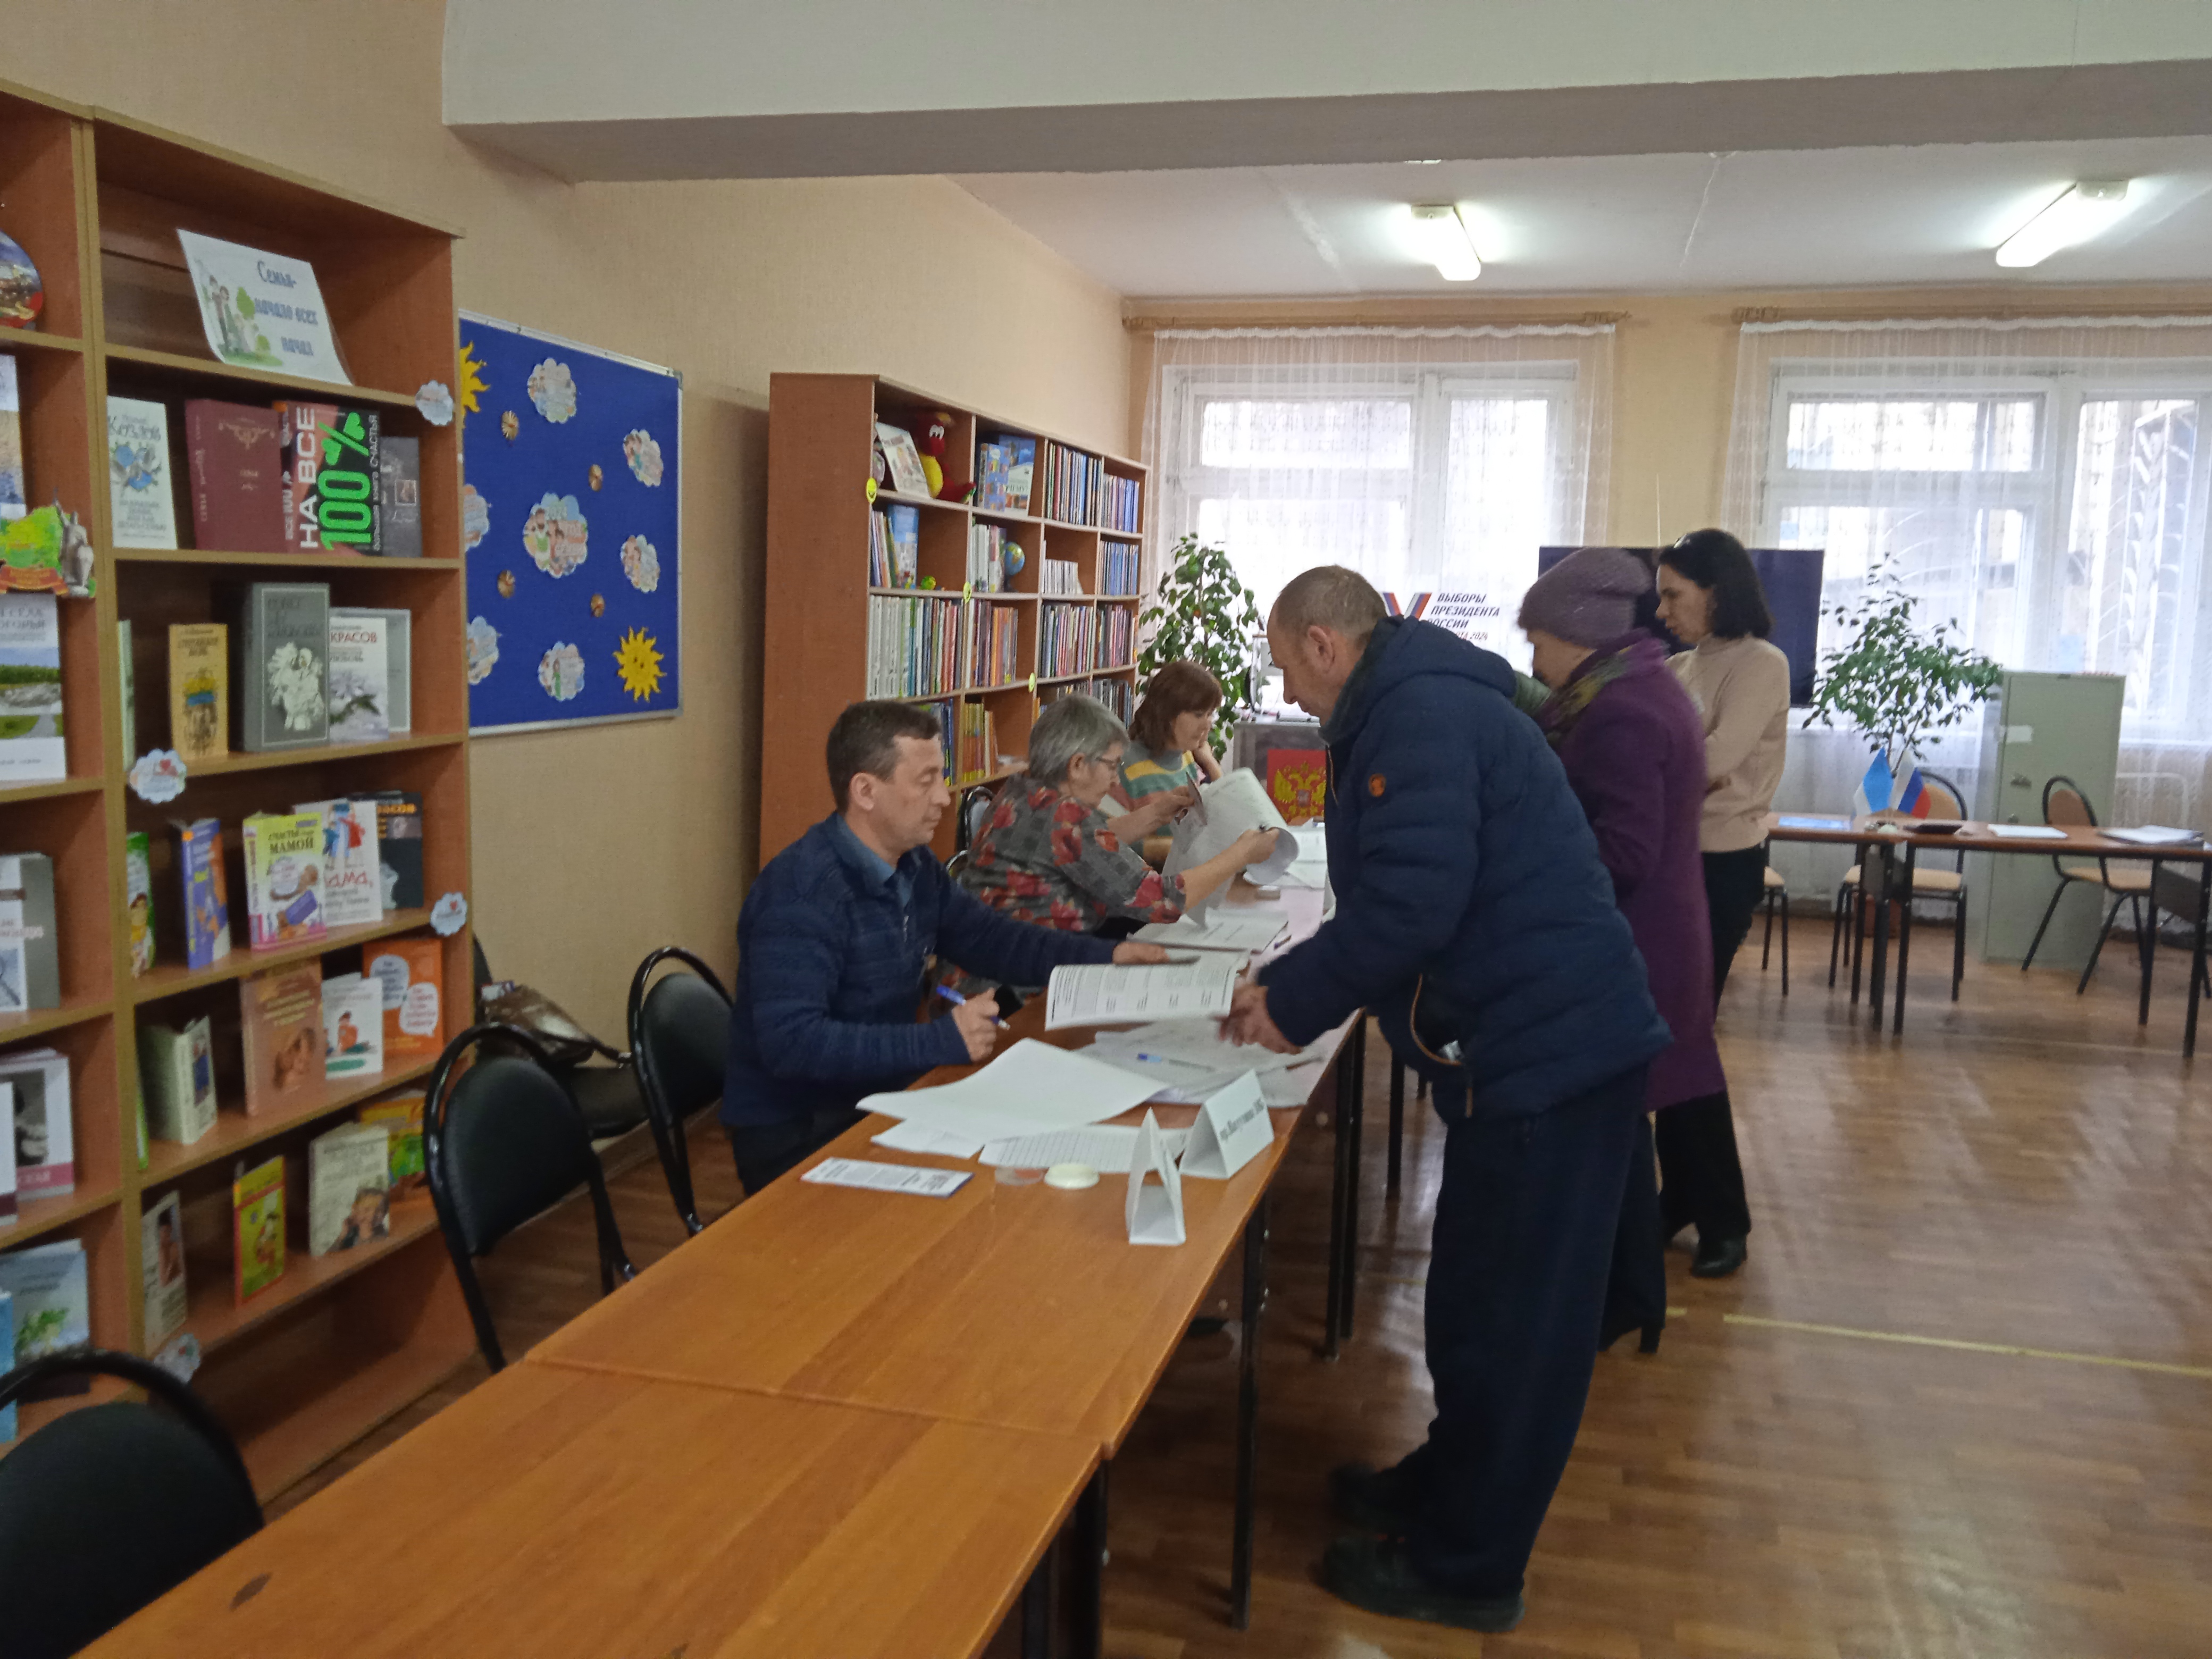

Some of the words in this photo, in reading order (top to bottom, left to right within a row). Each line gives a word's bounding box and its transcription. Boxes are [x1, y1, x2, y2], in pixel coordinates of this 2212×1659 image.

[296, 406, 316, 484] ВСЕ
[317, 412, 372, 551] 100%
[299, 493, 319, 549] НА
[1437, 593, 1487, 604] ВЫБОРЫ
[1430, 606, 1501, 617] ПРЕЗИДЕНТА
[330, 632, 377, 643] КРАСОВ
[1470, 631, 1488, 641] 2024
[270, 836, 314, 854] МАМОЙ
